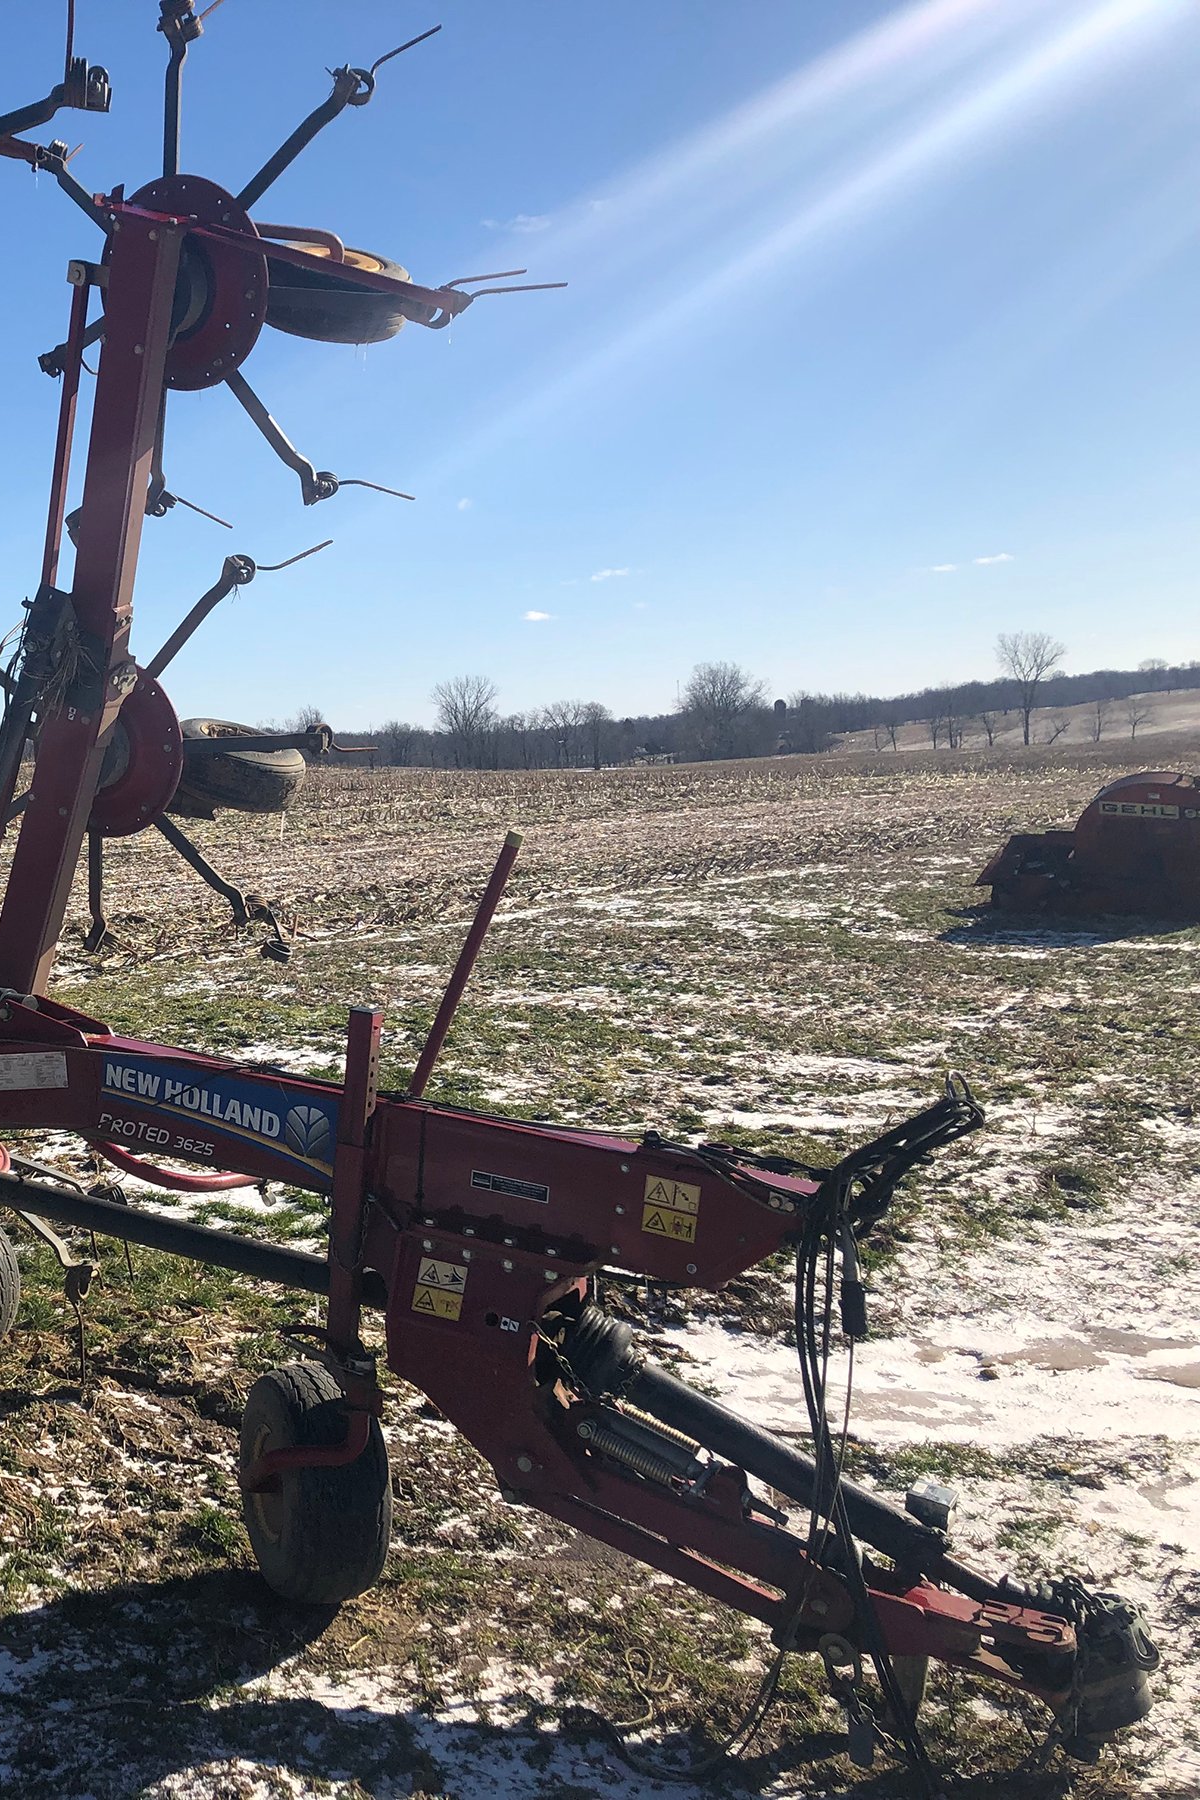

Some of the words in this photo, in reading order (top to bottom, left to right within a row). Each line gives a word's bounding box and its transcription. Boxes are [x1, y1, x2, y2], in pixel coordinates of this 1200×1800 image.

[1102, 803, 1177, 816] GEHL
[105, 1063, 161, 1098] NEW
[164, 1078, 281, 1138] HOLLAND
[98, 1113, 170, 1144] PROTED
[173, 1135, 215, 1156] 3625
